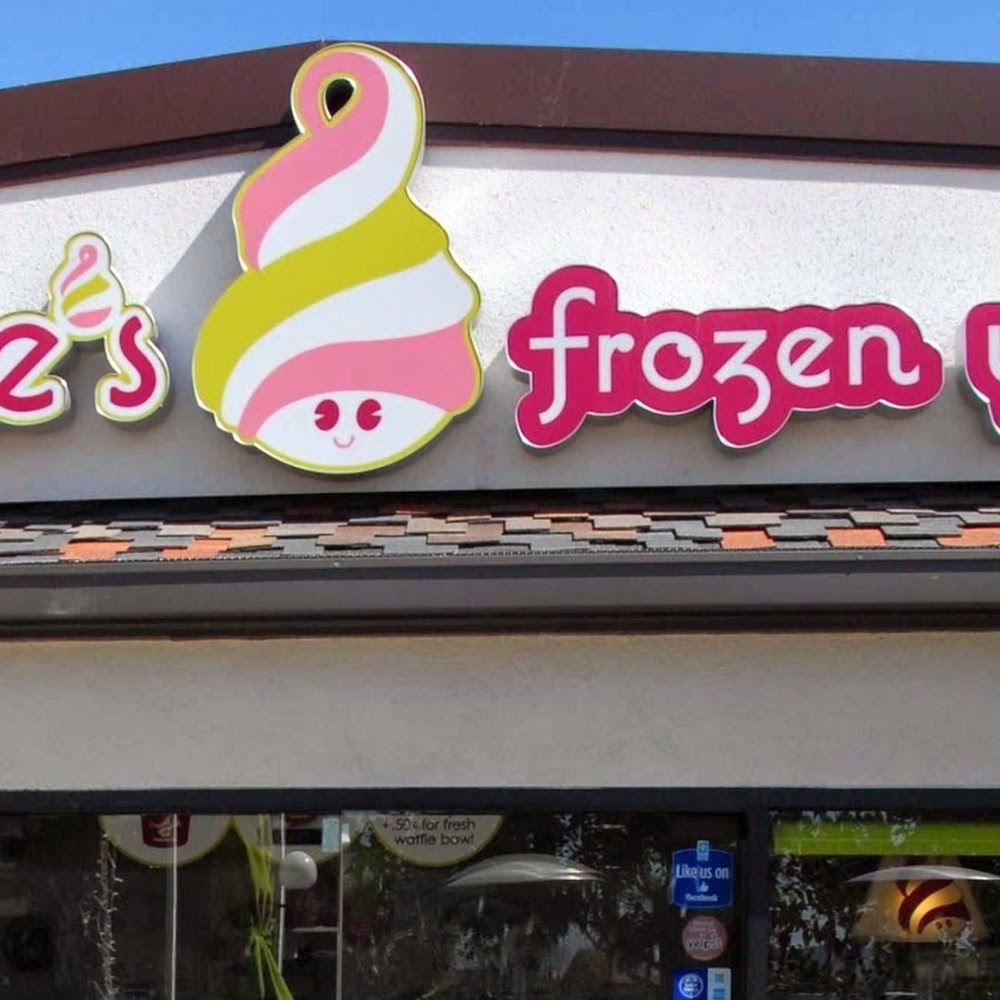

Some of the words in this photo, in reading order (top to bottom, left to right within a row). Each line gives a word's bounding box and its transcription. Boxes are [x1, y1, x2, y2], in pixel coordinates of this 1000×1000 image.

[529, 287, 921, 425] frozen
[422, 819, 439, 831] for
[444, 818, 476, 831] fresh
[395, 833, 437, 845] waffle
[676, 864, 698, 879] Like
[699, 867, 712, 879] us
[715, 867, 730, 879] on
